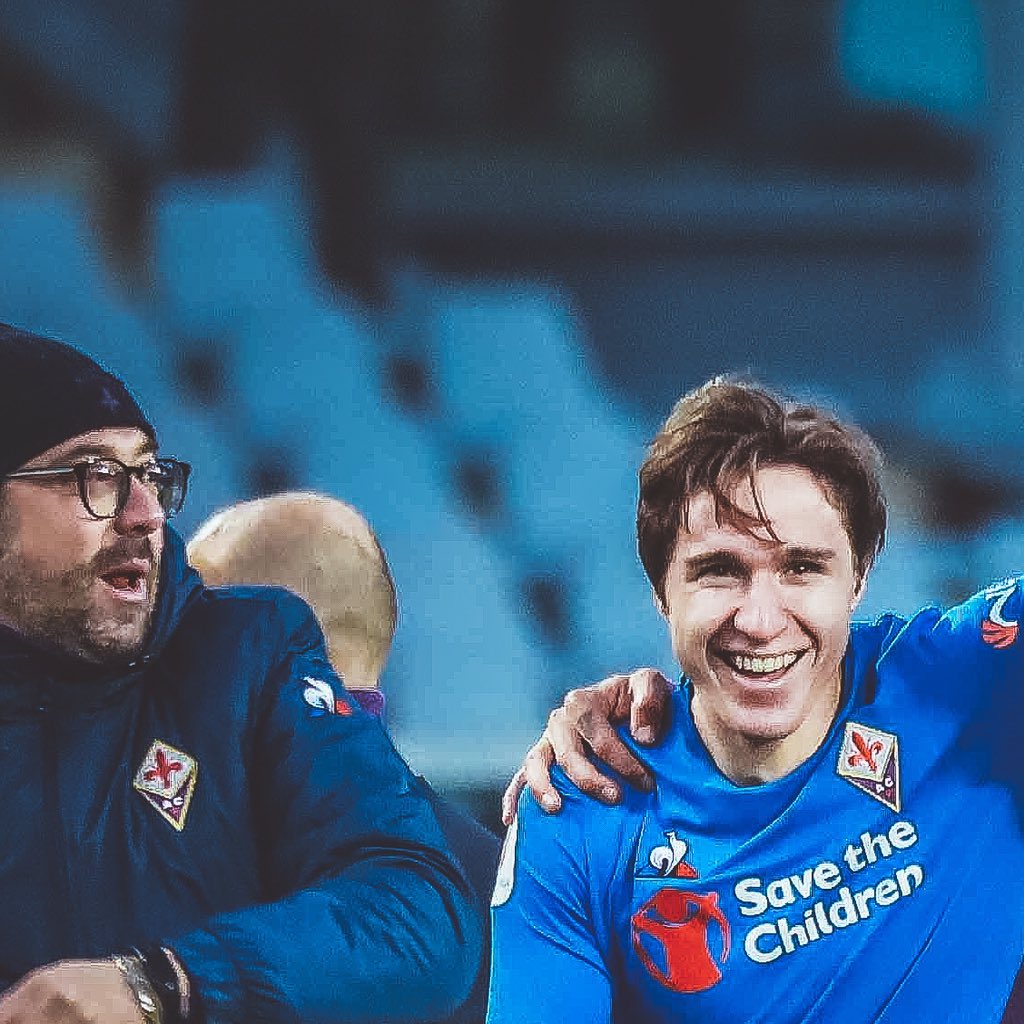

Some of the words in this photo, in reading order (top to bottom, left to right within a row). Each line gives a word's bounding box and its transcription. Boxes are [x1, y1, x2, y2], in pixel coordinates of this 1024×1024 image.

[734, 862, 842, 916] Save
[844, 821, 918, 872] the
[744, 865, 923, 963] Children
